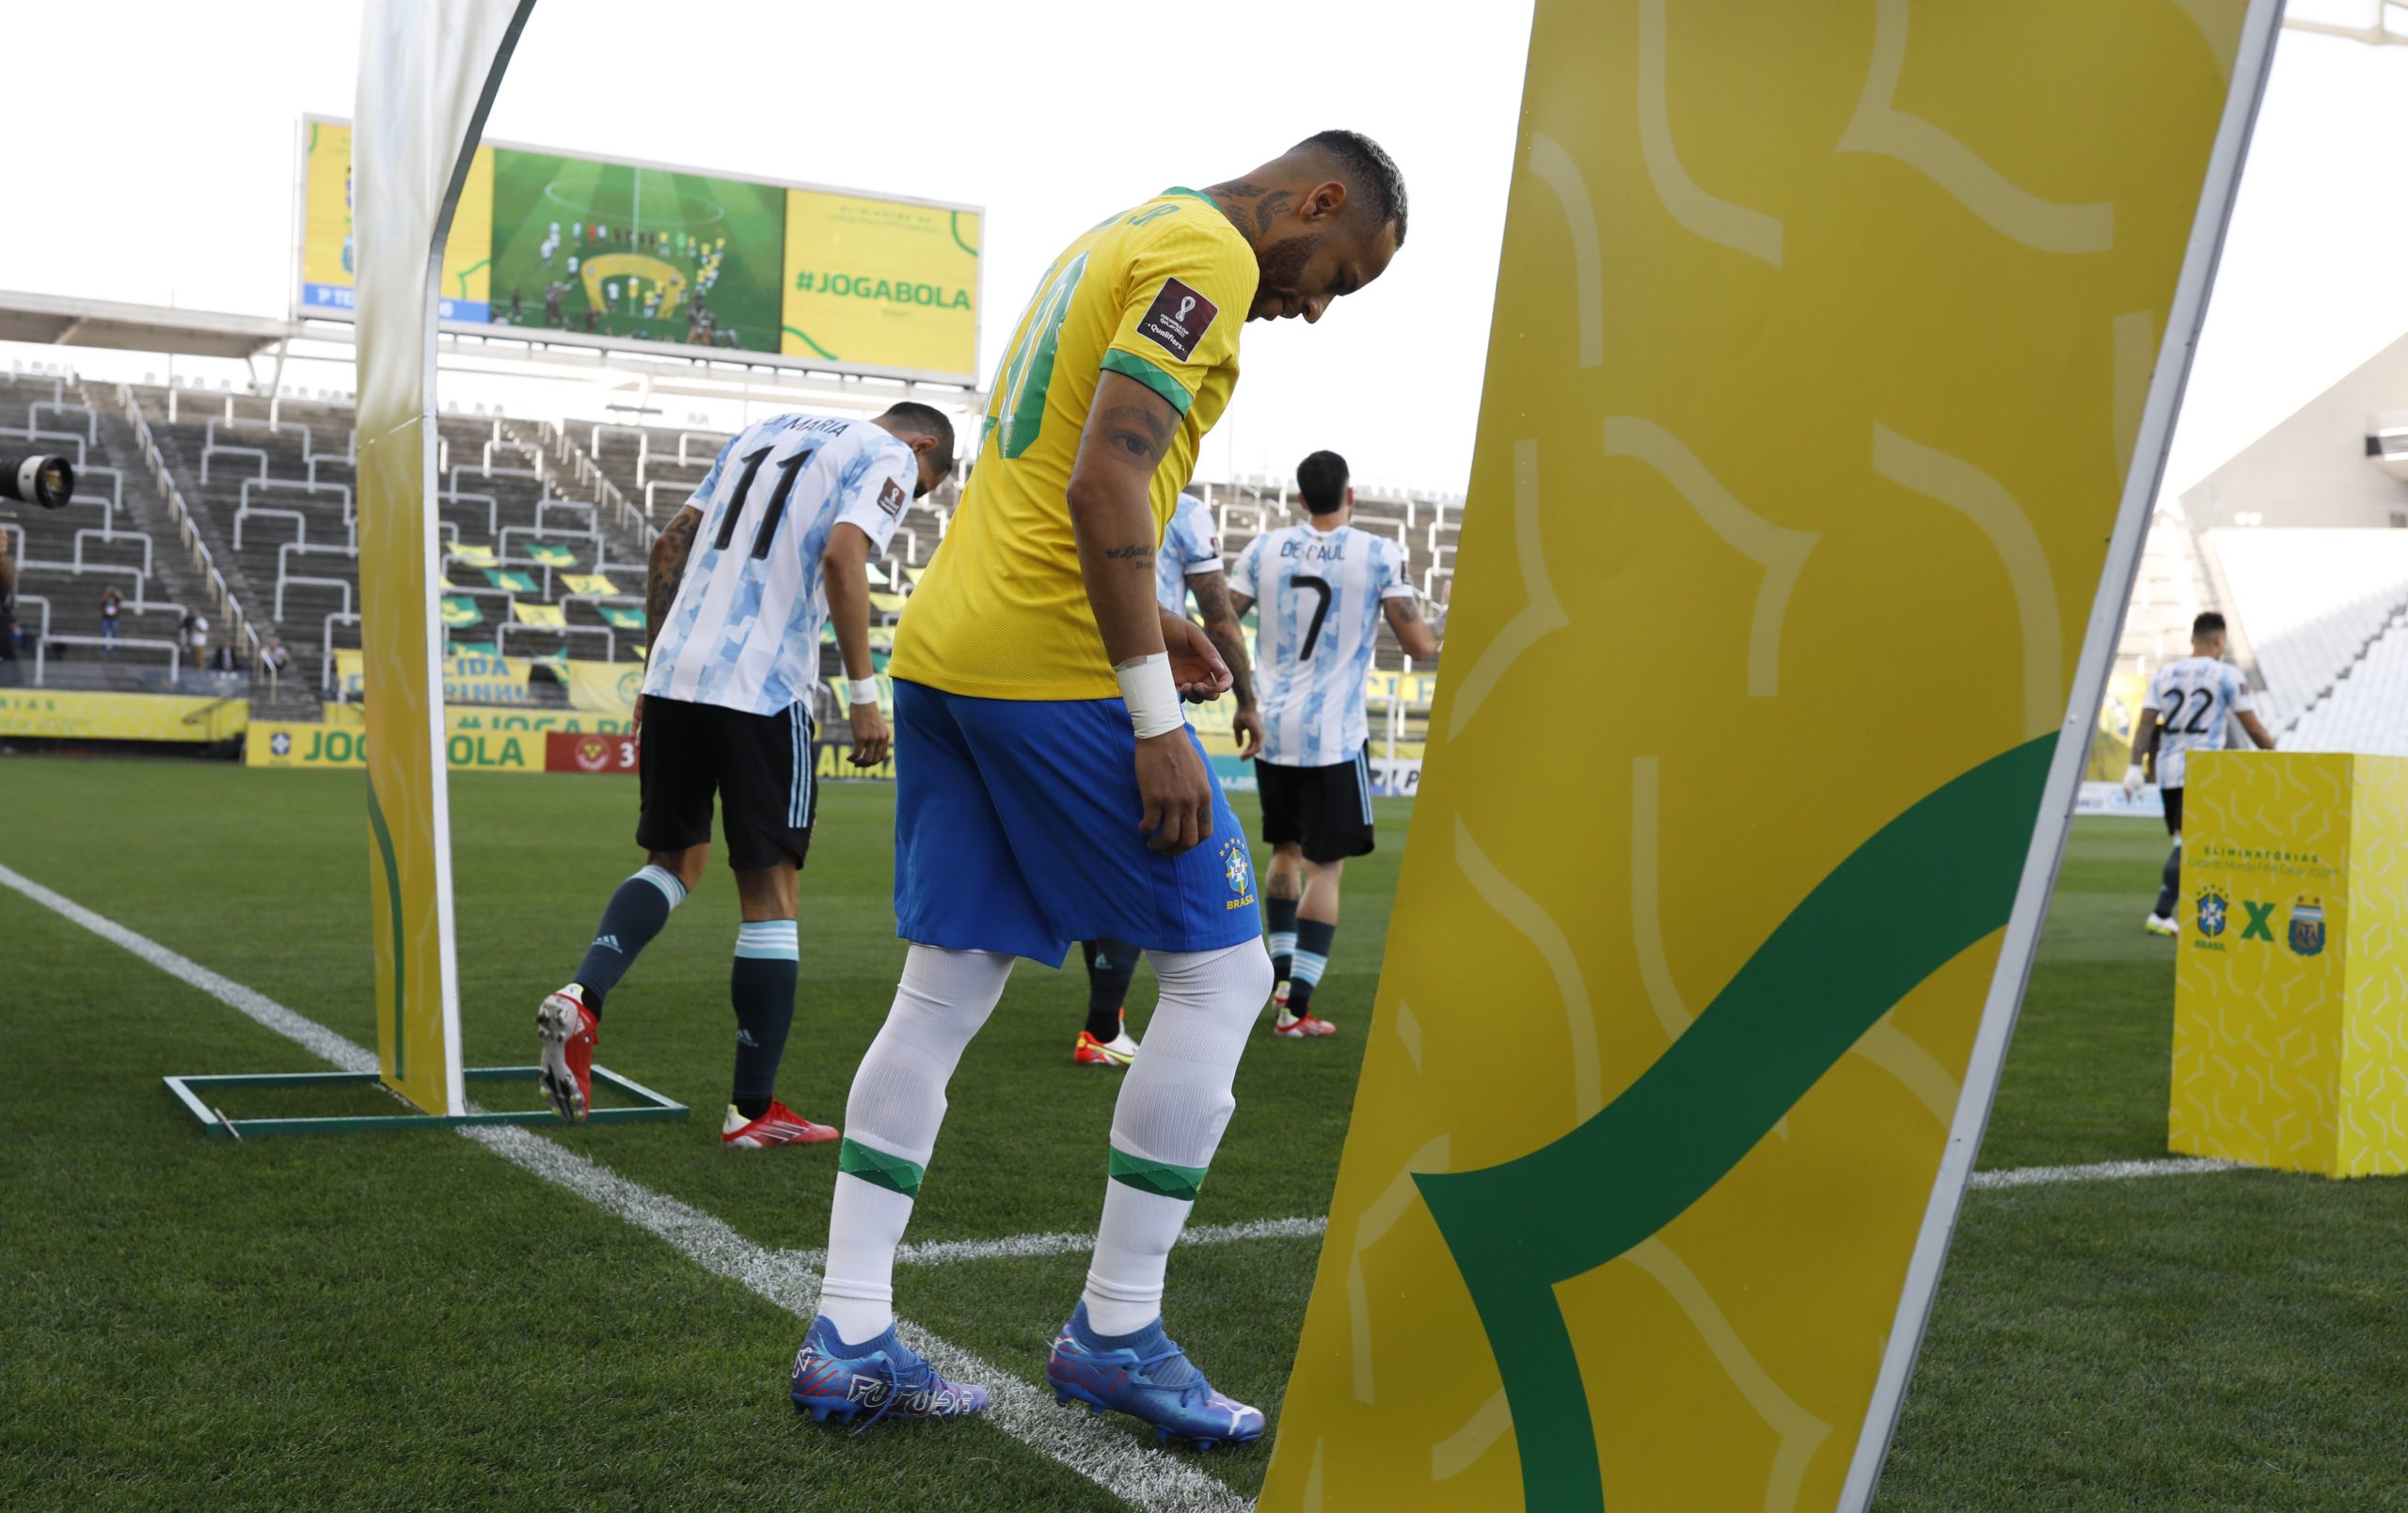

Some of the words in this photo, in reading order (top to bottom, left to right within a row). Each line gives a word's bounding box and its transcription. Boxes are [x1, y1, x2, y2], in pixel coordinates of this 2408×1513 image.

[795, 270, 972, 311] #JOGABOLA
[1150, 323, 1183, 351] Qualifiers
[714, 444, 814, 560] 11
[1280, 541, 1304, 559] DE
[1289, 575, 1332, 661] 7
[2162, 687, 2214, 734] 22
[1227, 893, 1256, 910] BRASIL
